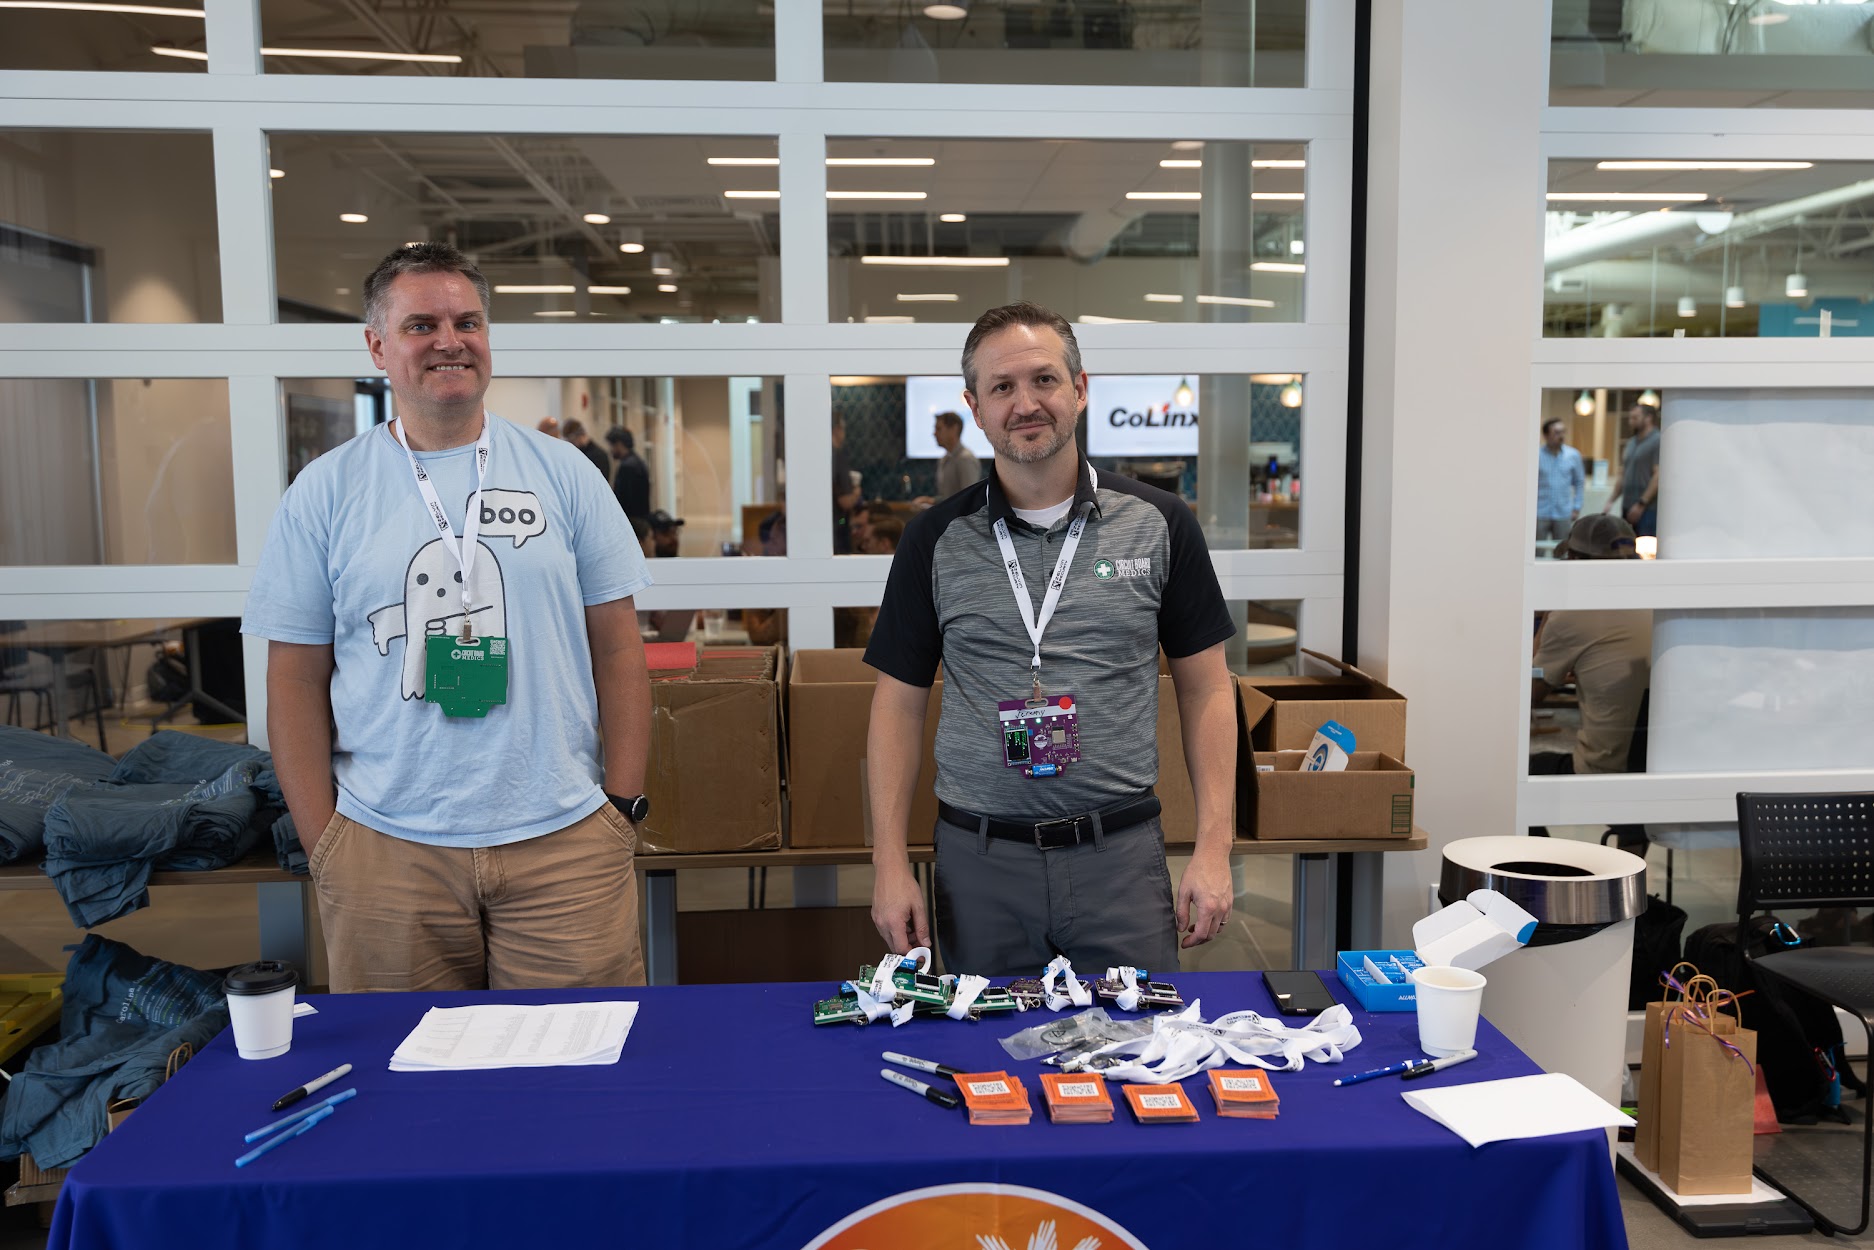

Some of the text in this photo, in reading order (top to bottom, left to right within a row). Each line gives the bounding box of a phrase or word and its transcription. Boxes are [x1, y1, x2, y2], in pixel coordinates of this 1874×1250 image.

[1109, 403, 1198, 428] CoLinx
[480, 498, 536, 526] boo
[1118, 569, 1150, 577] MEDICS
[115, 987, 135, 1024] Carolina
